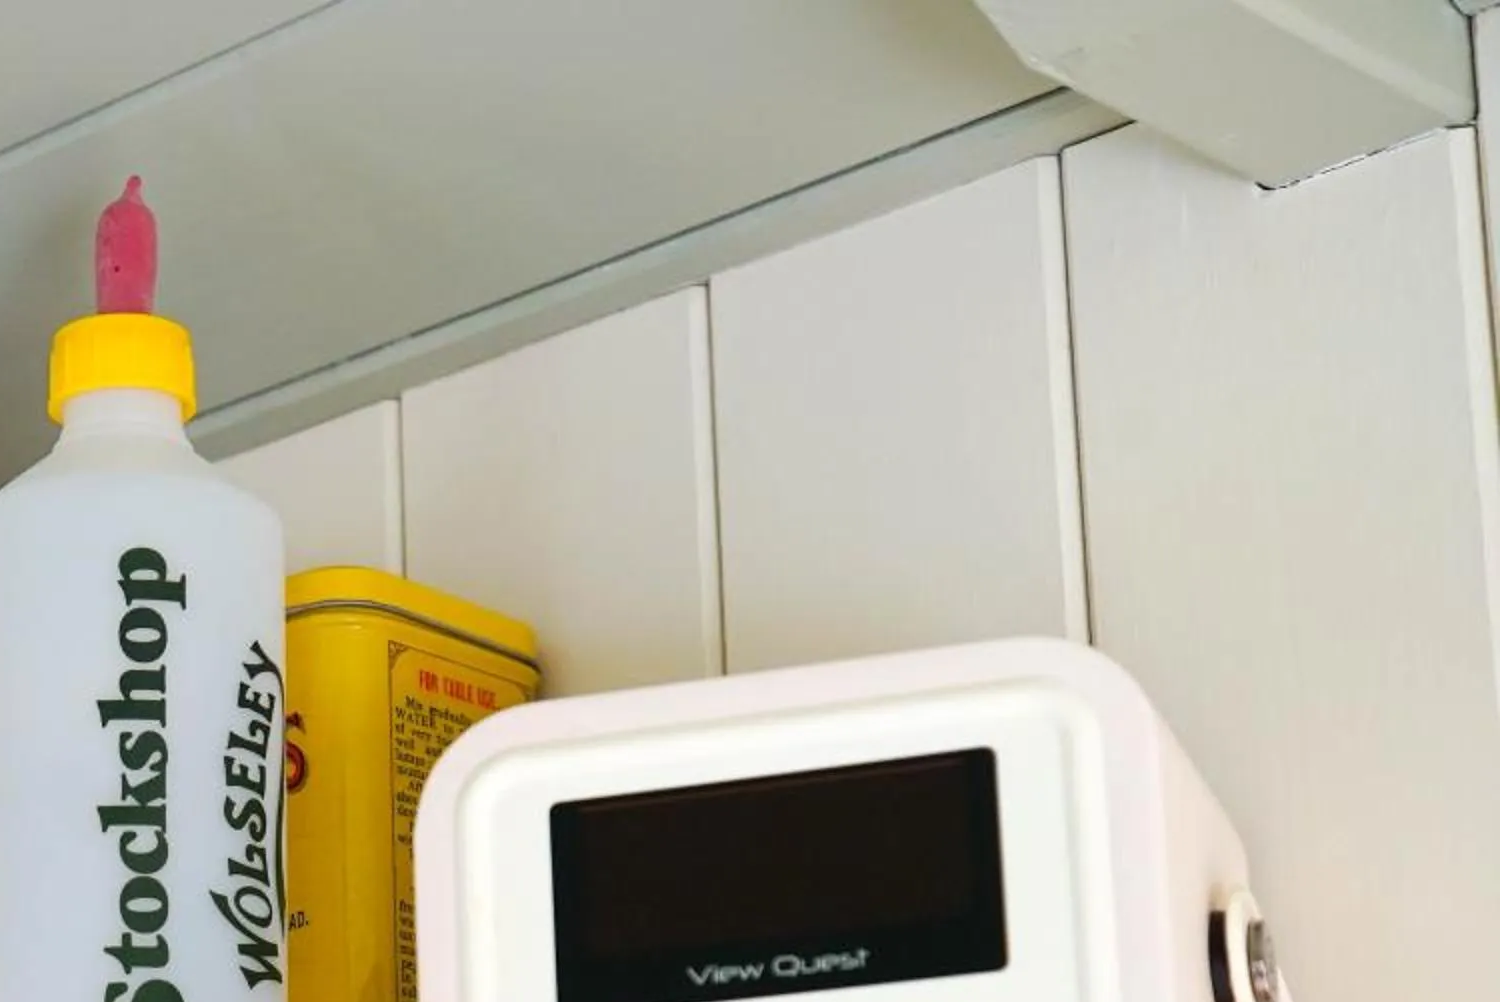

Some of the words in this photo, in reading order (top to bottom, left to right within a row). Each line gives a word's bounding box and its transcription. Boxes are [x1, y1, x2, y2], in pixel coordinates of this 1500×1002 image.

[208, 640, 284, 990] WOLSELEY
[685, 961, 765, 986] View
[771, 948, 870, 977] Quest
